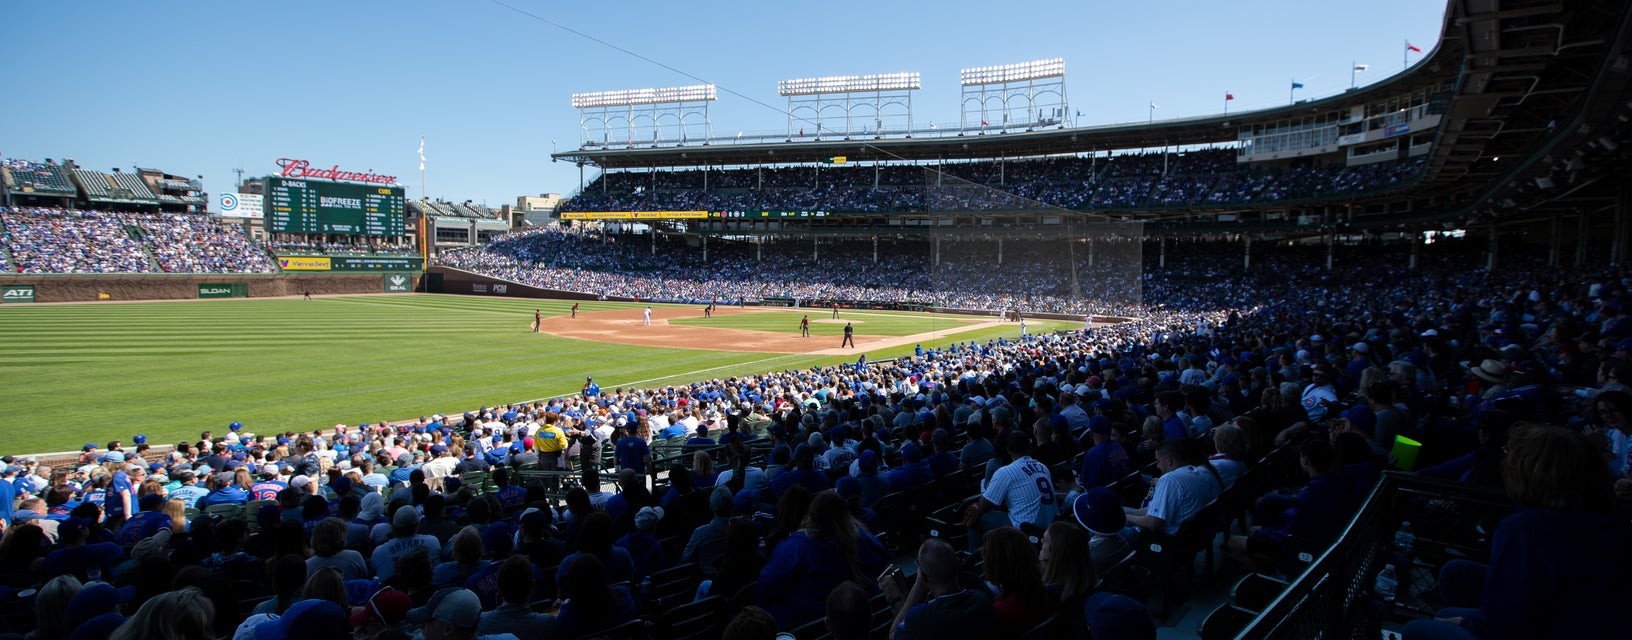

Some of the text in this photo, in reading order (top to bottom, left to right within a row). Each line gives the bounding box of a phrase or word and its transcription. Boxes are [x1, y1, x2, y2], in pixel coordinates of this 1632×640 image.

[275, 158, 397, 183] Budweiser
[281, 180, 307, 188] D-BACKS
[320, 196, 361, 206] BIOFREEZE
[1036, 477, 1054, 505] 9
[389, 539, 425, 553] BRYANT
